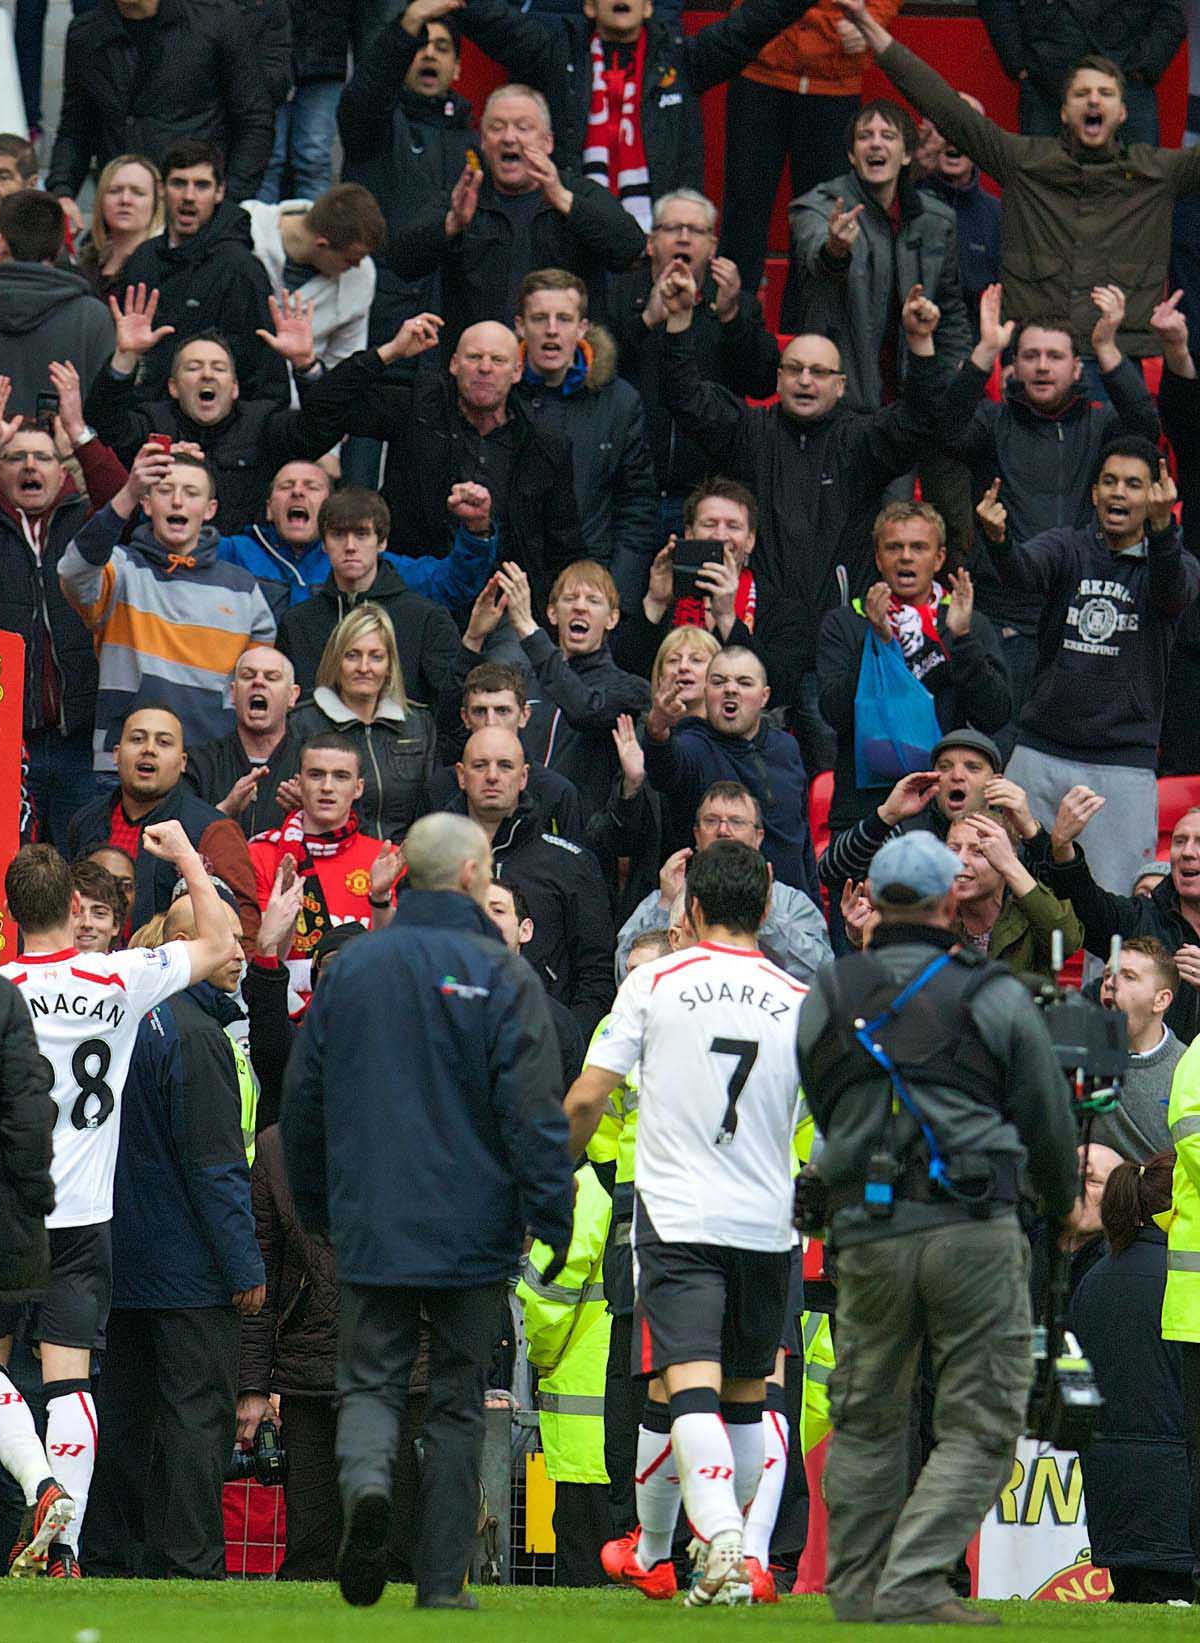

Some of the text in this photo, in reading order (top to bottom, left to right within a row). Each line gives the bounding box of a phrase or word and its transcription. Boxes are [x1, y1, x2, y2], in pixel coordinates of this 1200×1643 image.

[29, 993, 126, 1029] NAGAN
[679, 981, 790, 1023] SUAREZ
[709, 1036, 759, 1144] 7
[1054, 1568, 1115, 1602] NC
